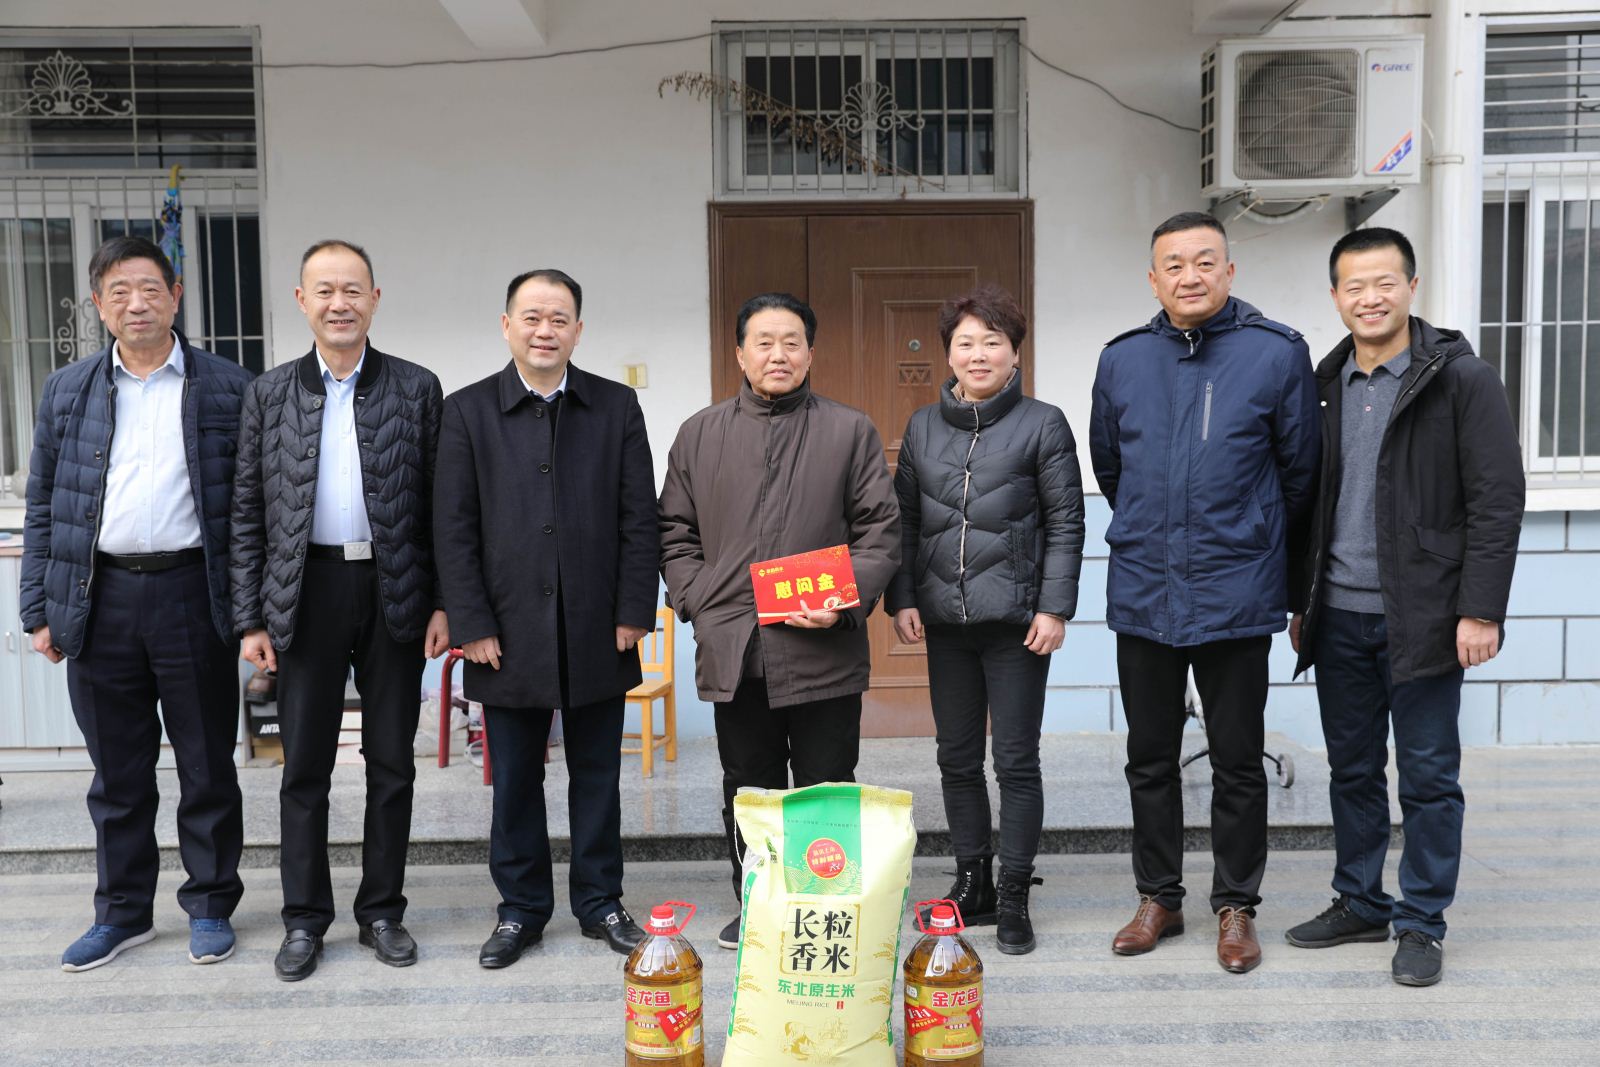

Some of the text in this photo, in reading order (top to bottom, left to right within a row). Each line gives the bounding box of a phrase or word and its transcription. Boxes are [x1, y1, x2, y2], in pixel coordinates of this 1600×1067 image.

[1383, 63, 1413, 72] GREE
[775, 573, 835, 599] 慰问金
[788, 908, 853, 942] 长粒
[788, 942, 851, 973] 香米
[627, 986, 670, 1006] 金龙鱼
[777, 979, 856, 998] 东北原生米
[933, 987, 978, 1007] 金龙鱼
